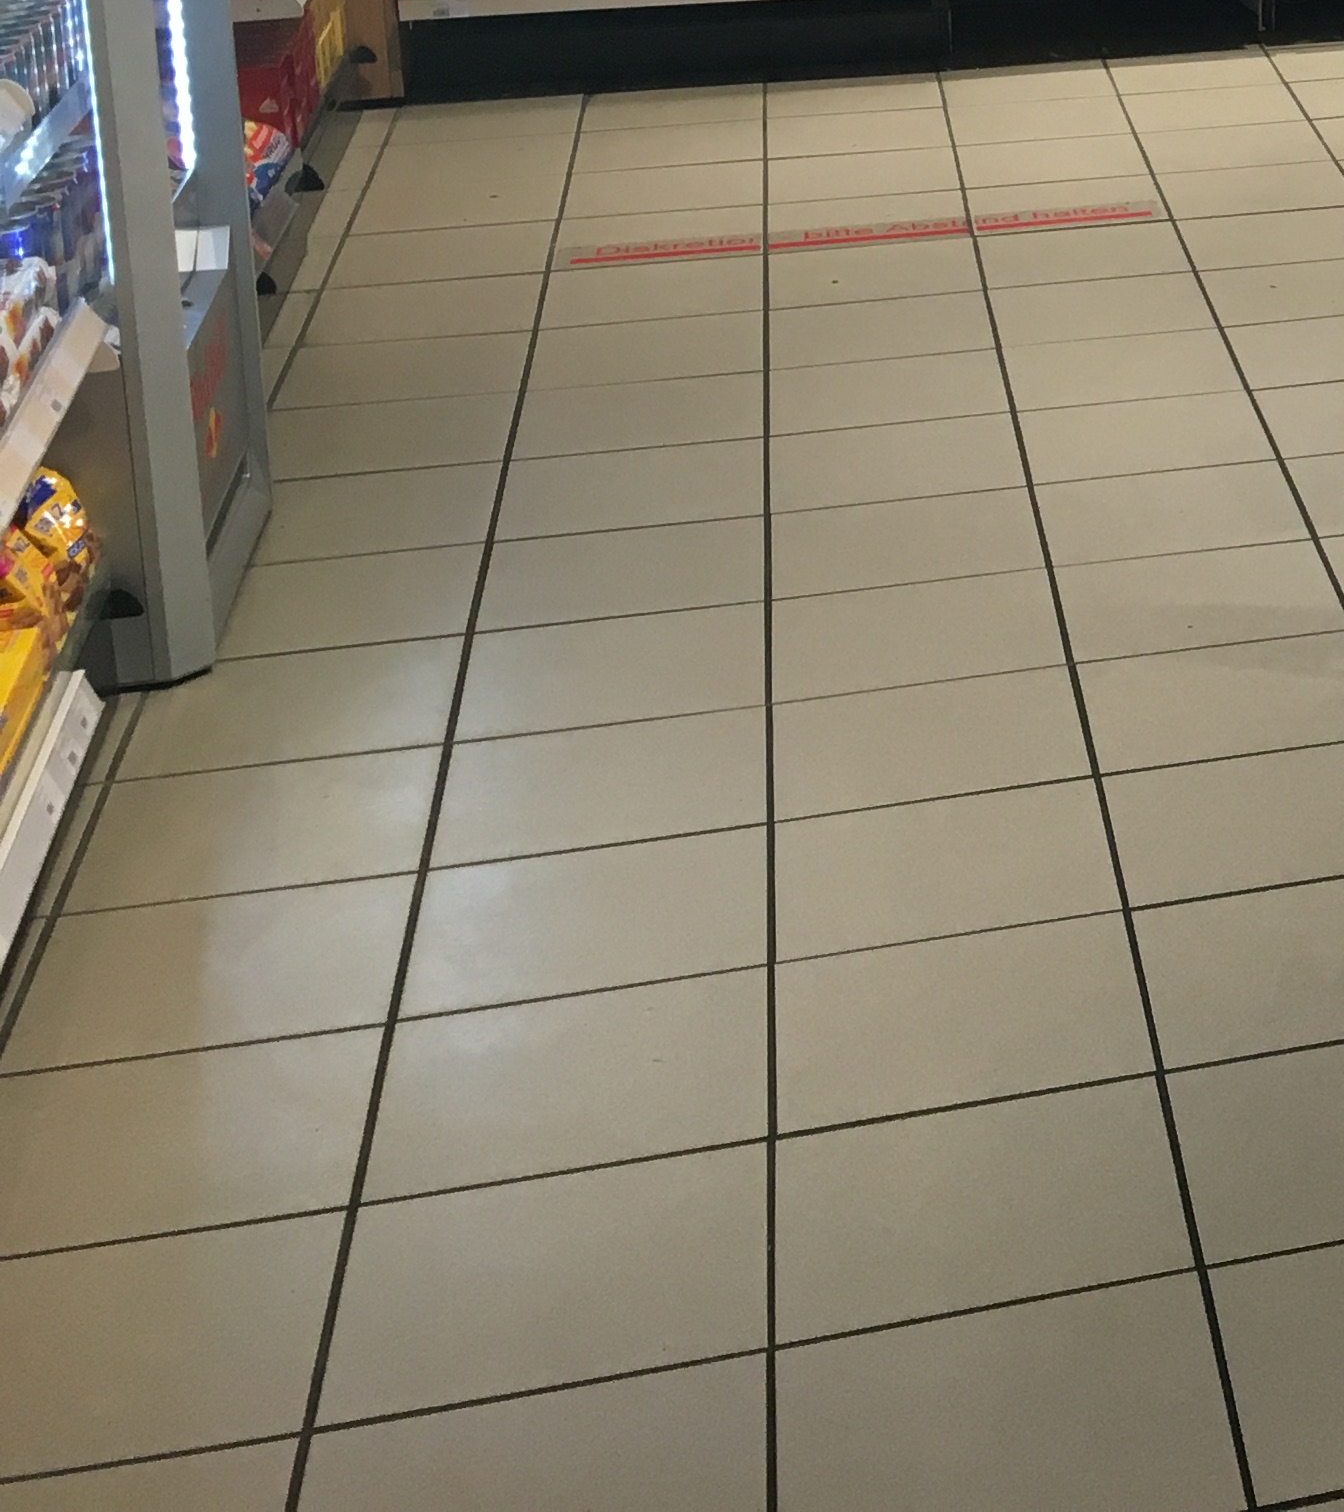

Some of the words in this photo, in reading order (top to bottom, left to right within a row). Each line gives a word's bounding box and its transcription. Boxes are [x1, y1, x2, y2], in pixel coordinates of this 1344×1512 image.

[596, 237, 755, 257] Diskretio
[804, 226, 873, 241] bitte
[1033, 205, 1128, 219] halten
